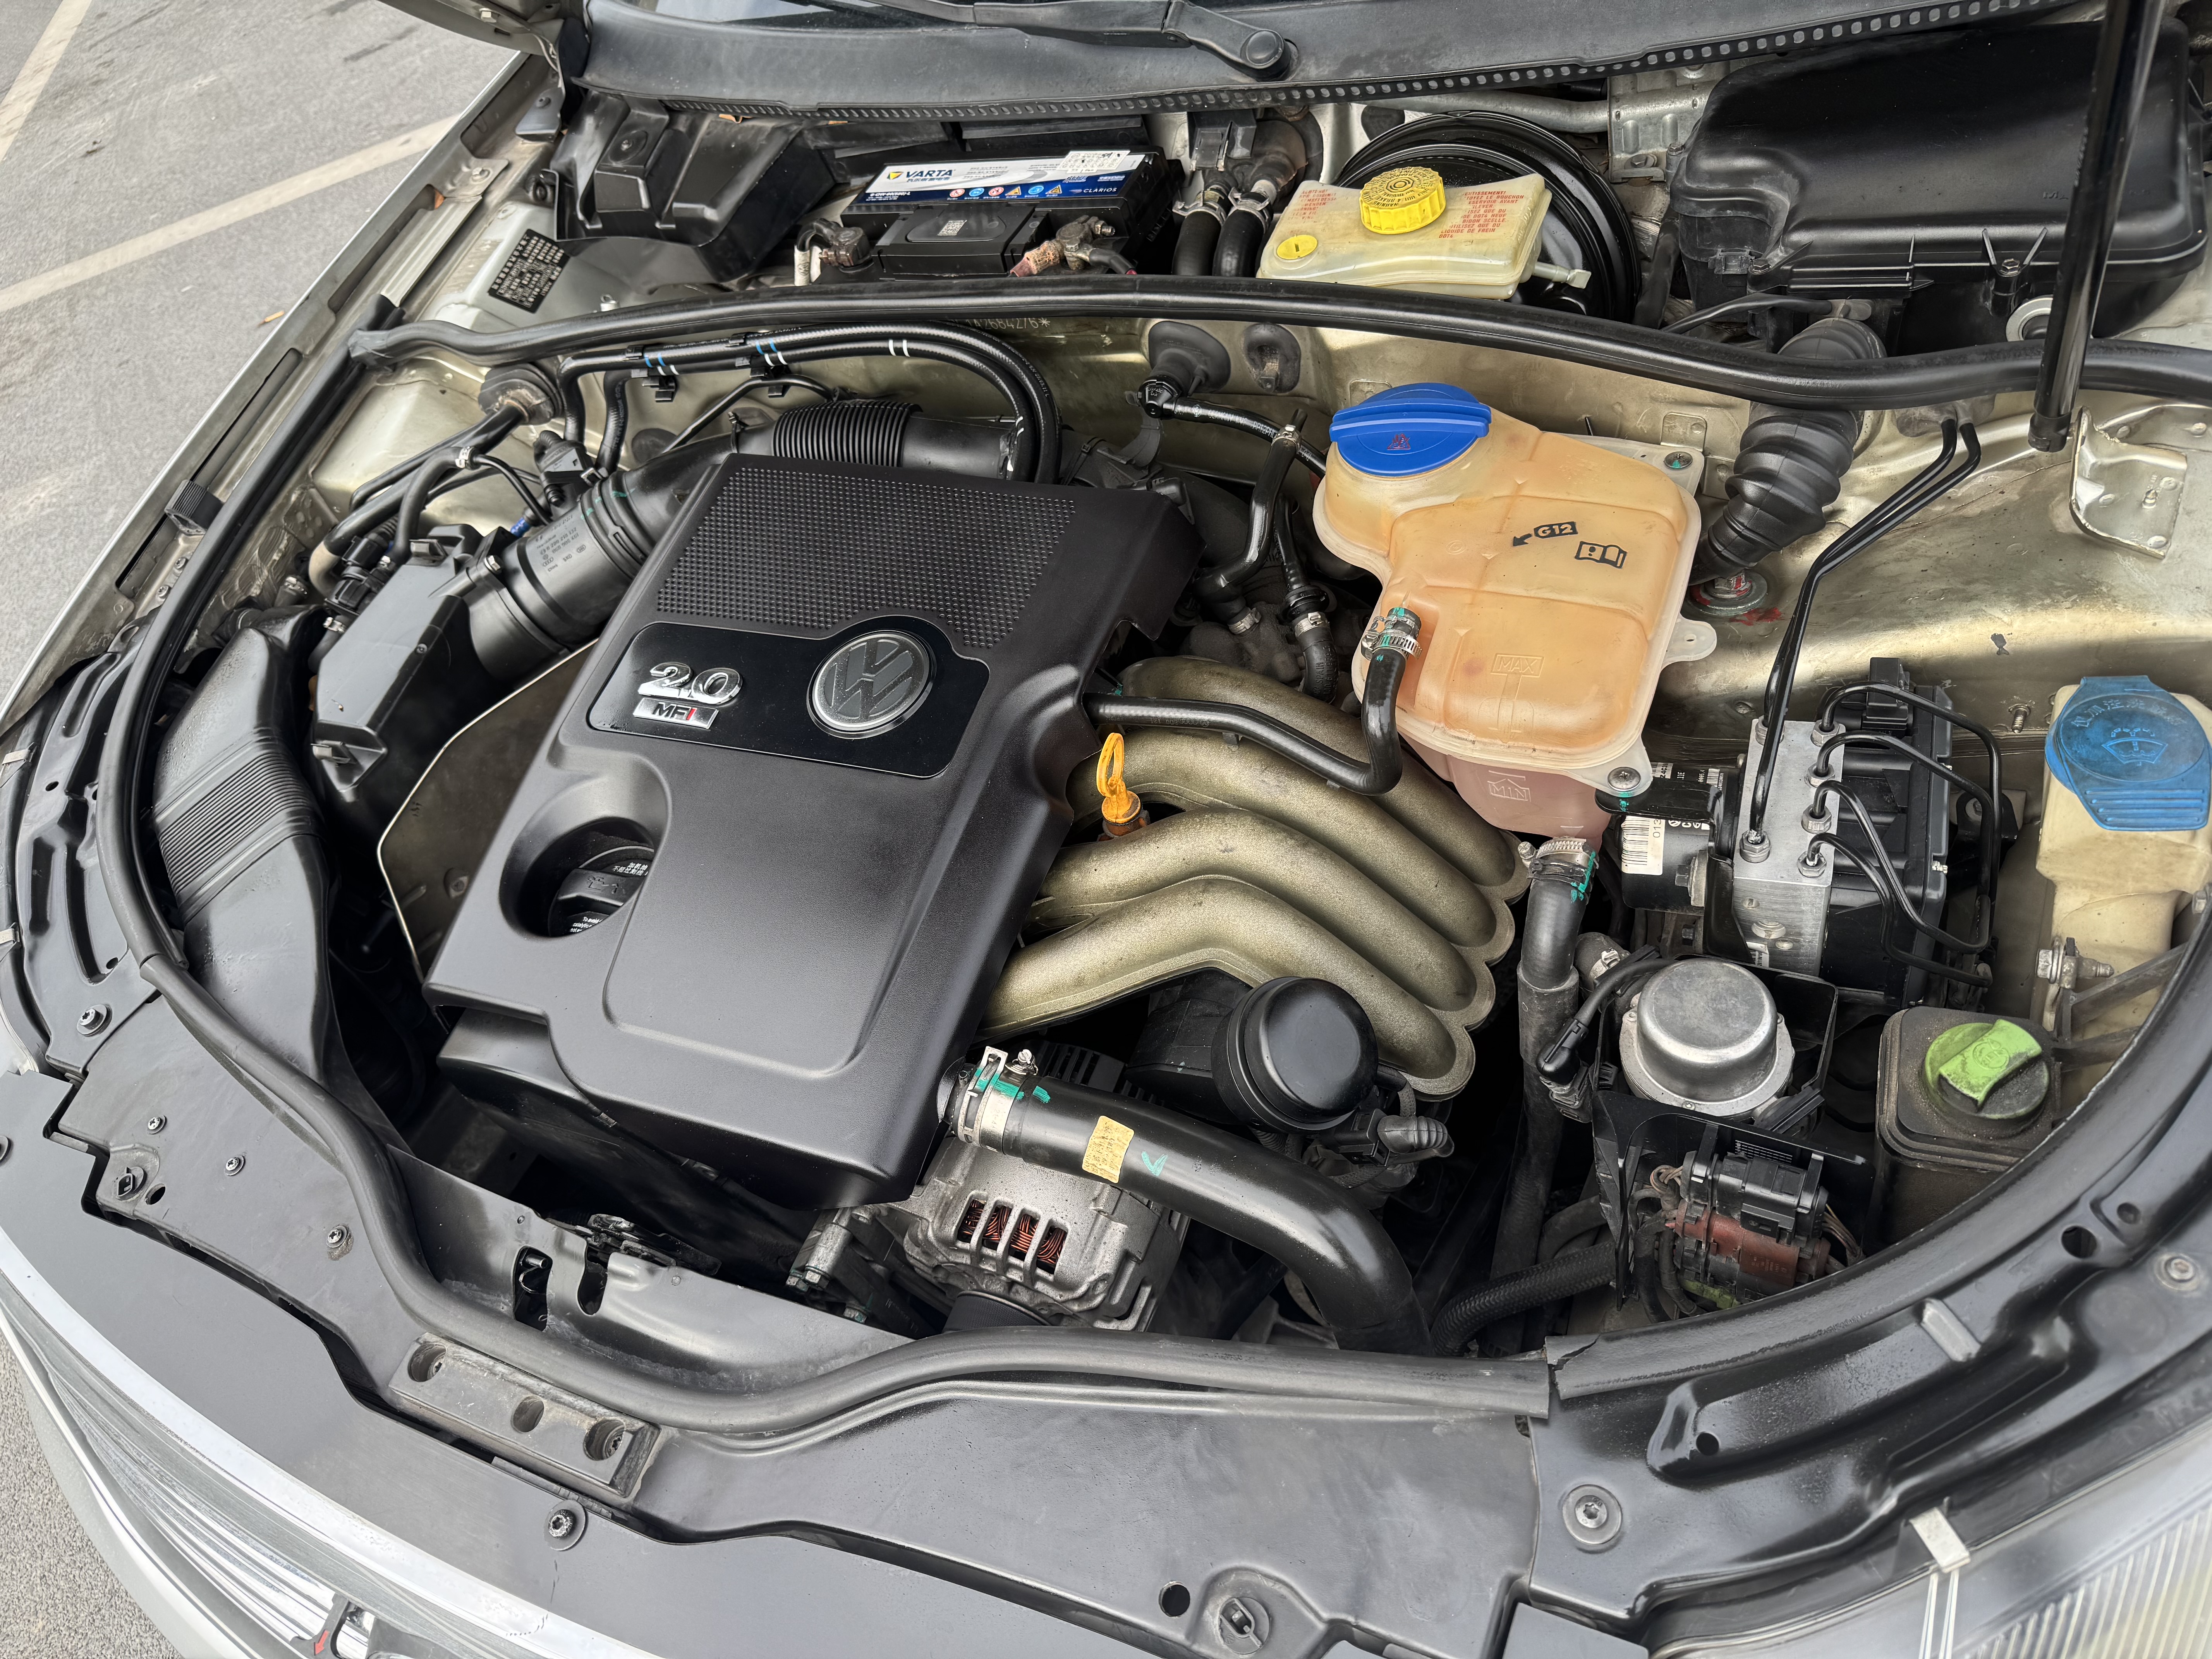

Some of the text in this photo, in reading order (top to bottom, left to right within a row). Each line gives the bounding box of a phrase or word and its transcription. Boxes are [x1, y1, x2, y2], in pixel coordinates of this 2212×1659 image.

[906, 170, 953, 178] VARTA
[1538, 523, 1574, 537] G12
[1316, 662, 1324, 684] SPAIN
[1498, 657, 1538, 673] MAX
[638, 661, 743, 706] 2.0
[652, 702, 698, 721] MFI
[1492, 784, 1529, 800] MIN
[1653, 819, 1661, 838] 013
